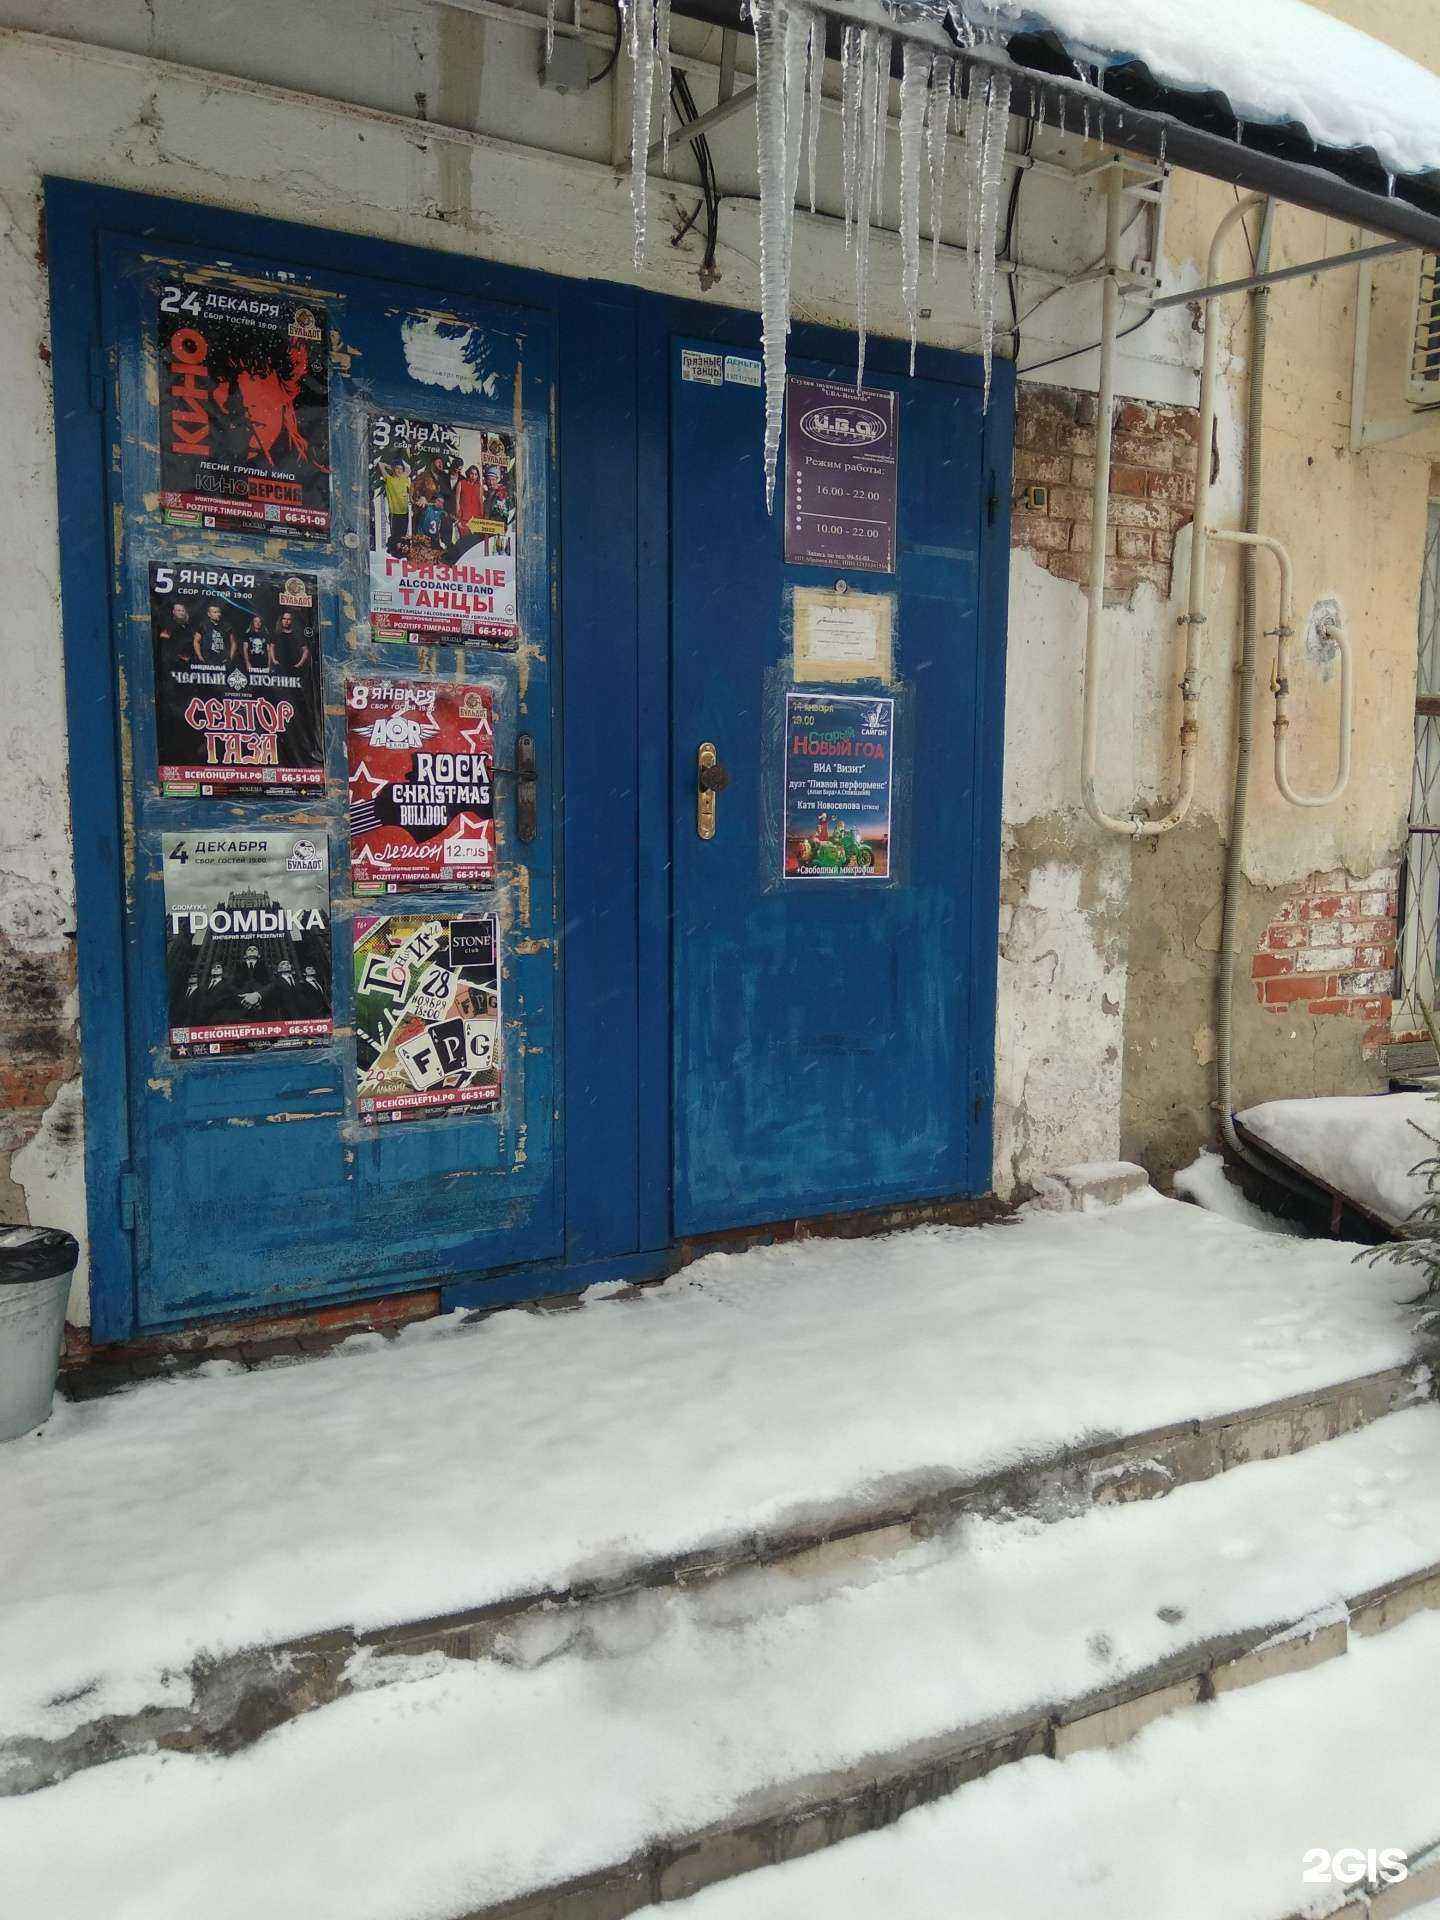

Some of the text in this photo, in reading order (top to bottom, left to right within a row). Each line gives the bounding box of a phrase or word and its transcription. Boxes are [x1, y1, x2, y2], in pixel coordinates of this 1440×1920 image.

[160, 286, 279, 317] 24 ДЕКАБРЯ
[203, 312, 224, 321] СБОР
[170, 328, 210, 456] КИНО
[373, 421, 461, 446] 3 ЯНВАРЯ
[200, 461, 295, 480] ПЕСНИ ГРУППЫ КИНО
[805, 456, 842, 469] Режим
[817, 485, 844, 497] 16.00
[853, 490, 880, 501] 22.00
[186, 503, 264, 520] POZITIFF.TIMEPAD.RU
[285, 513, 327, 526] 66-51-09
[816, 524, 843, 535] 10.00
[852, 528, 879, 538] 22.00
[154, 568, 256, 594] 5 ЯНВАРЯ
[385, 558, 506, 588] ГРЯЗНЫЕ
[178, 588, 199, 596] СБОР
[201, 589, 231, 598] ГОСТЕЙ
[399, 579, 494, 595] ALCODANCE BAND
[398, 588, 495, 614] ТАНЦЫ
[478, 627, 514, 637] 66-51-09
[352, 686, 436, 710] 8 ЯНВАРЯ
[184, 697, 295, 732] СЕКТОР
[369, 717, 423, 748] AOR
[861, 727, 888, 736] САЙГОН
[204, 731, 279, 765] ГАЗА
[184, 770, 321, 783] ВСЕКОНЦЕРТЫ.РФ 66-51-09
[416, 753, 490, 786] ROCK
[813, 763, 832, 773] ВИА
[788, 780, 806, 790] дуэт
[392, 784, 490, 805] CHRISTMAS
[797, 800, 816, 809] Катя
[817, 801, 861, 810] Новоселова
[400, 804, 448, 826] BULLDOG
[169, 841, 268, 864] 4 ДЕКАБРЯ
[287, 859, 323, 870] БУЛЬДОГ
[839, 867, 875, 876] микрофон
[456, 871, 491, 879] 66-51-09
[171, 908, 326, 934] ГРОМЫКА
[452, 936, 492, 947] STONE
[421, 969, 450, 998] 28
[411, 995, 447, 1009] НОЯБРЯ
[190, 1027, 282, 1040] ВСЕКОНЦЕРТЫ.РФ
[289, 1024, 328, 1034] 66-51-09
[366, 1069, 385, 1081] 20
[375, 1093, 456, 1109] ВСЕКОНЦЕРТЫ.РФ
[461, 1089, 496, 1101] 66-51-09
